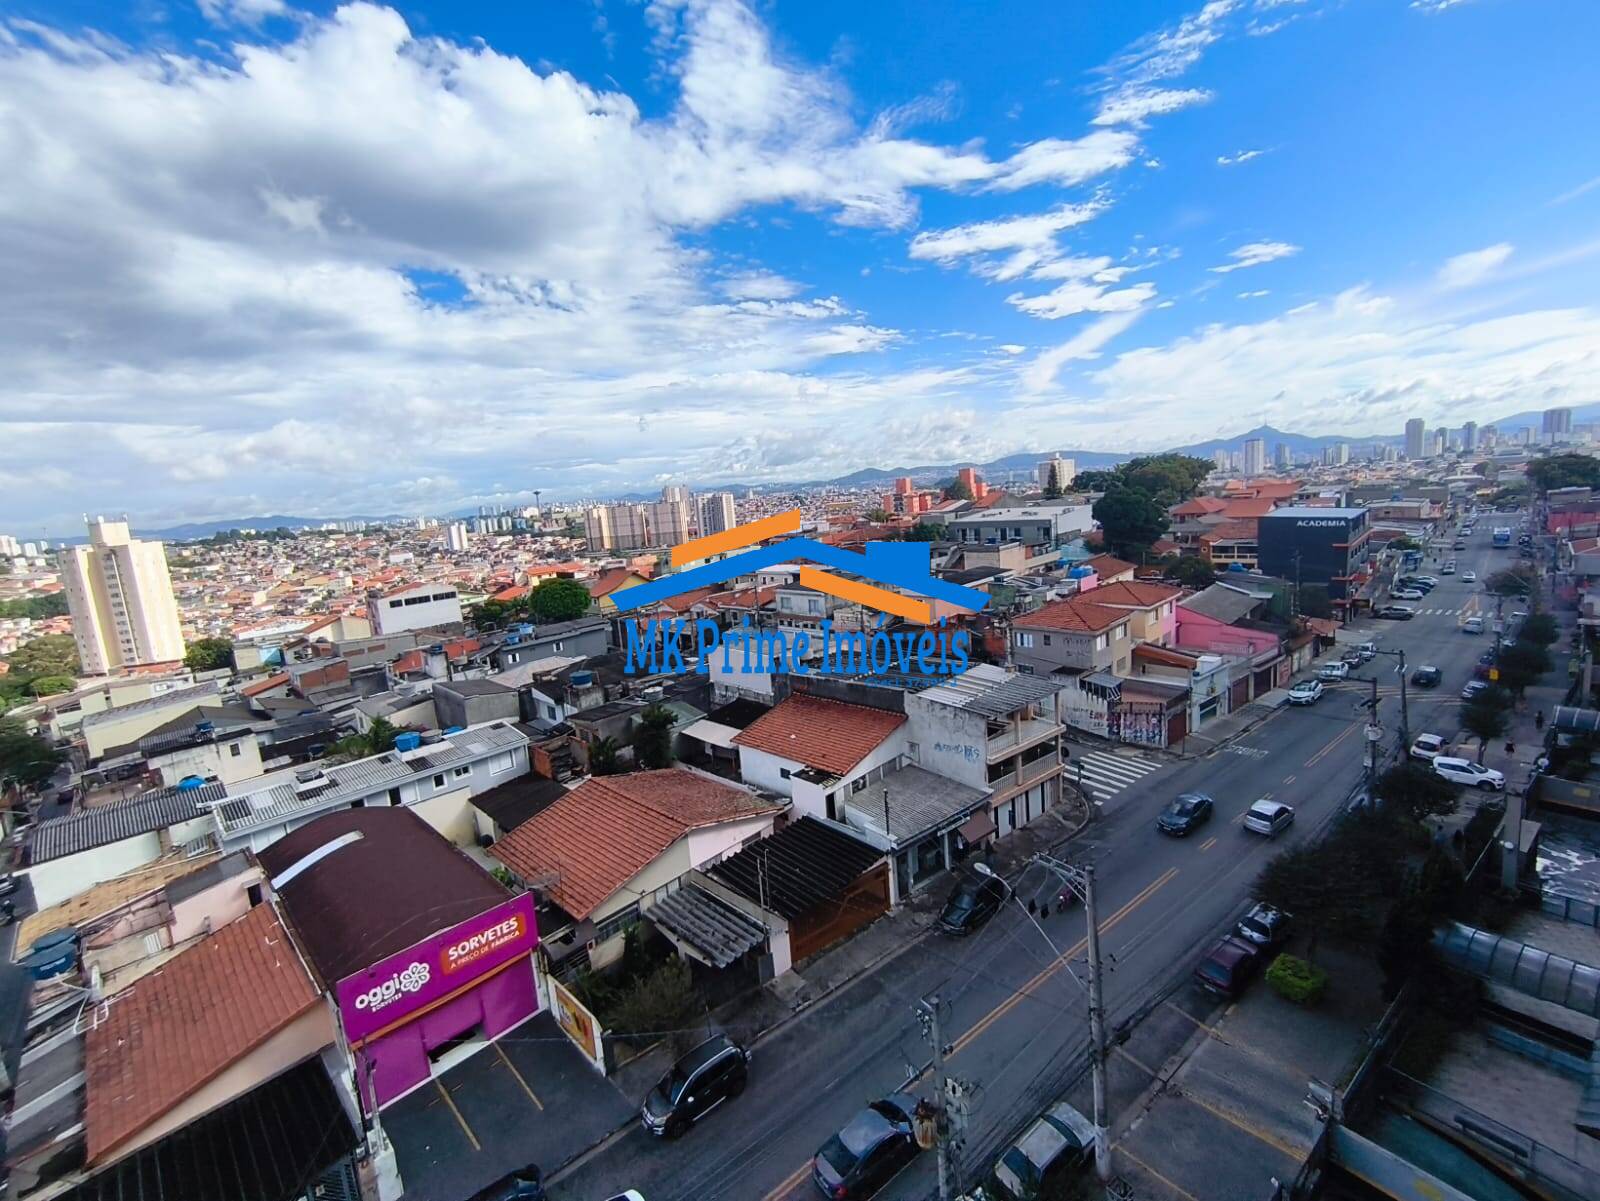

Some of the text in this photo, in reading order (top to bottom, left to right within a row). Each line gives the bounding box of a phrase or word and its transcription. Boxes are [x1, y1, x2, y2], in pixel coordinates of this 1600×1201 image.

[1297, 519, 1346, 527] ACADEMIA
[448, 917, 519, 960] SORVETES
[457, 951, 480, 965] PREÇO
[480, 946, 489, 954] DE
[491, 930, 520, 949] FÁBRICA
[355, 973, 401, 1008] oggi
